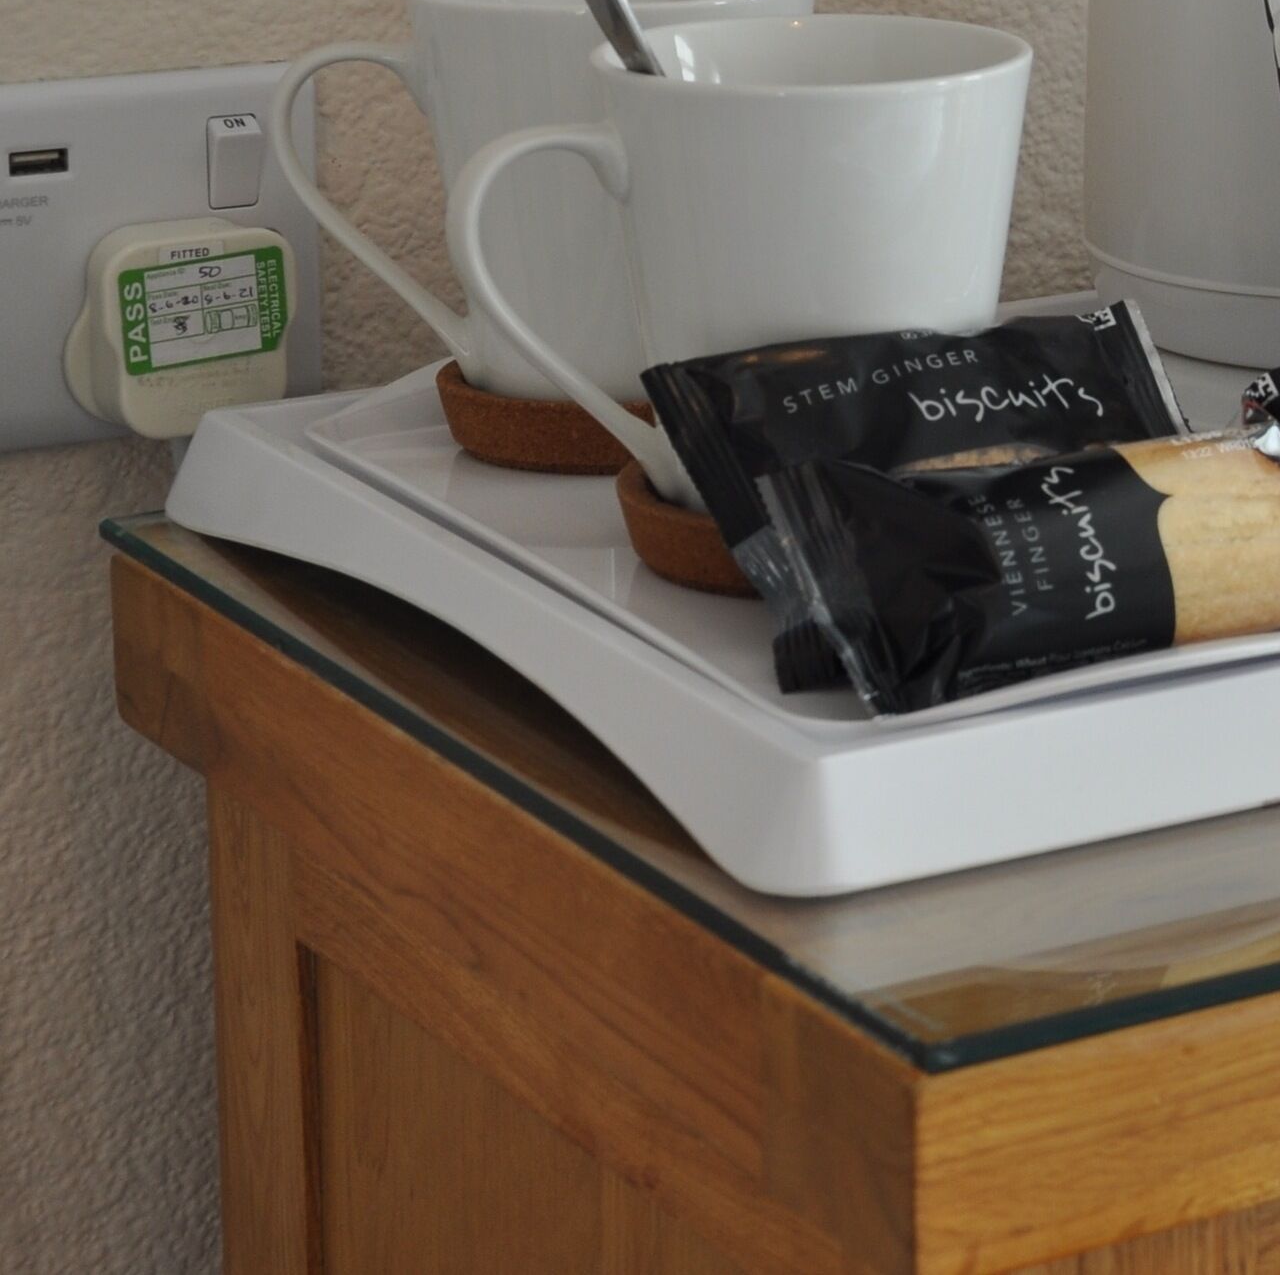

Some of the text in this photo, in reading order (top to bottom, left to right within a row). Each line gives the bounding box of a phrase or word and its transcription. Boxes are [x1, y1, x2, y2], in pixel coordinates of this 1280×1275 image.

[223, 118, 246, 129] ON
[170, 247, 210, 260] FITTED
[124, 282, 149, 363] PASS
[256, 261, 271, 338] SAFETY TEST
[266, 259, 281, 338] ELECTRICAL
[783, 348, 979, 414] STEM GINGER
[908, 373, 1104, 423] biscuits
[968, 494, 1028, 616] VIENNESE
[1006, 498, 1054, 591] FINGER
[1040, 466, 1117, 620] biscuits
